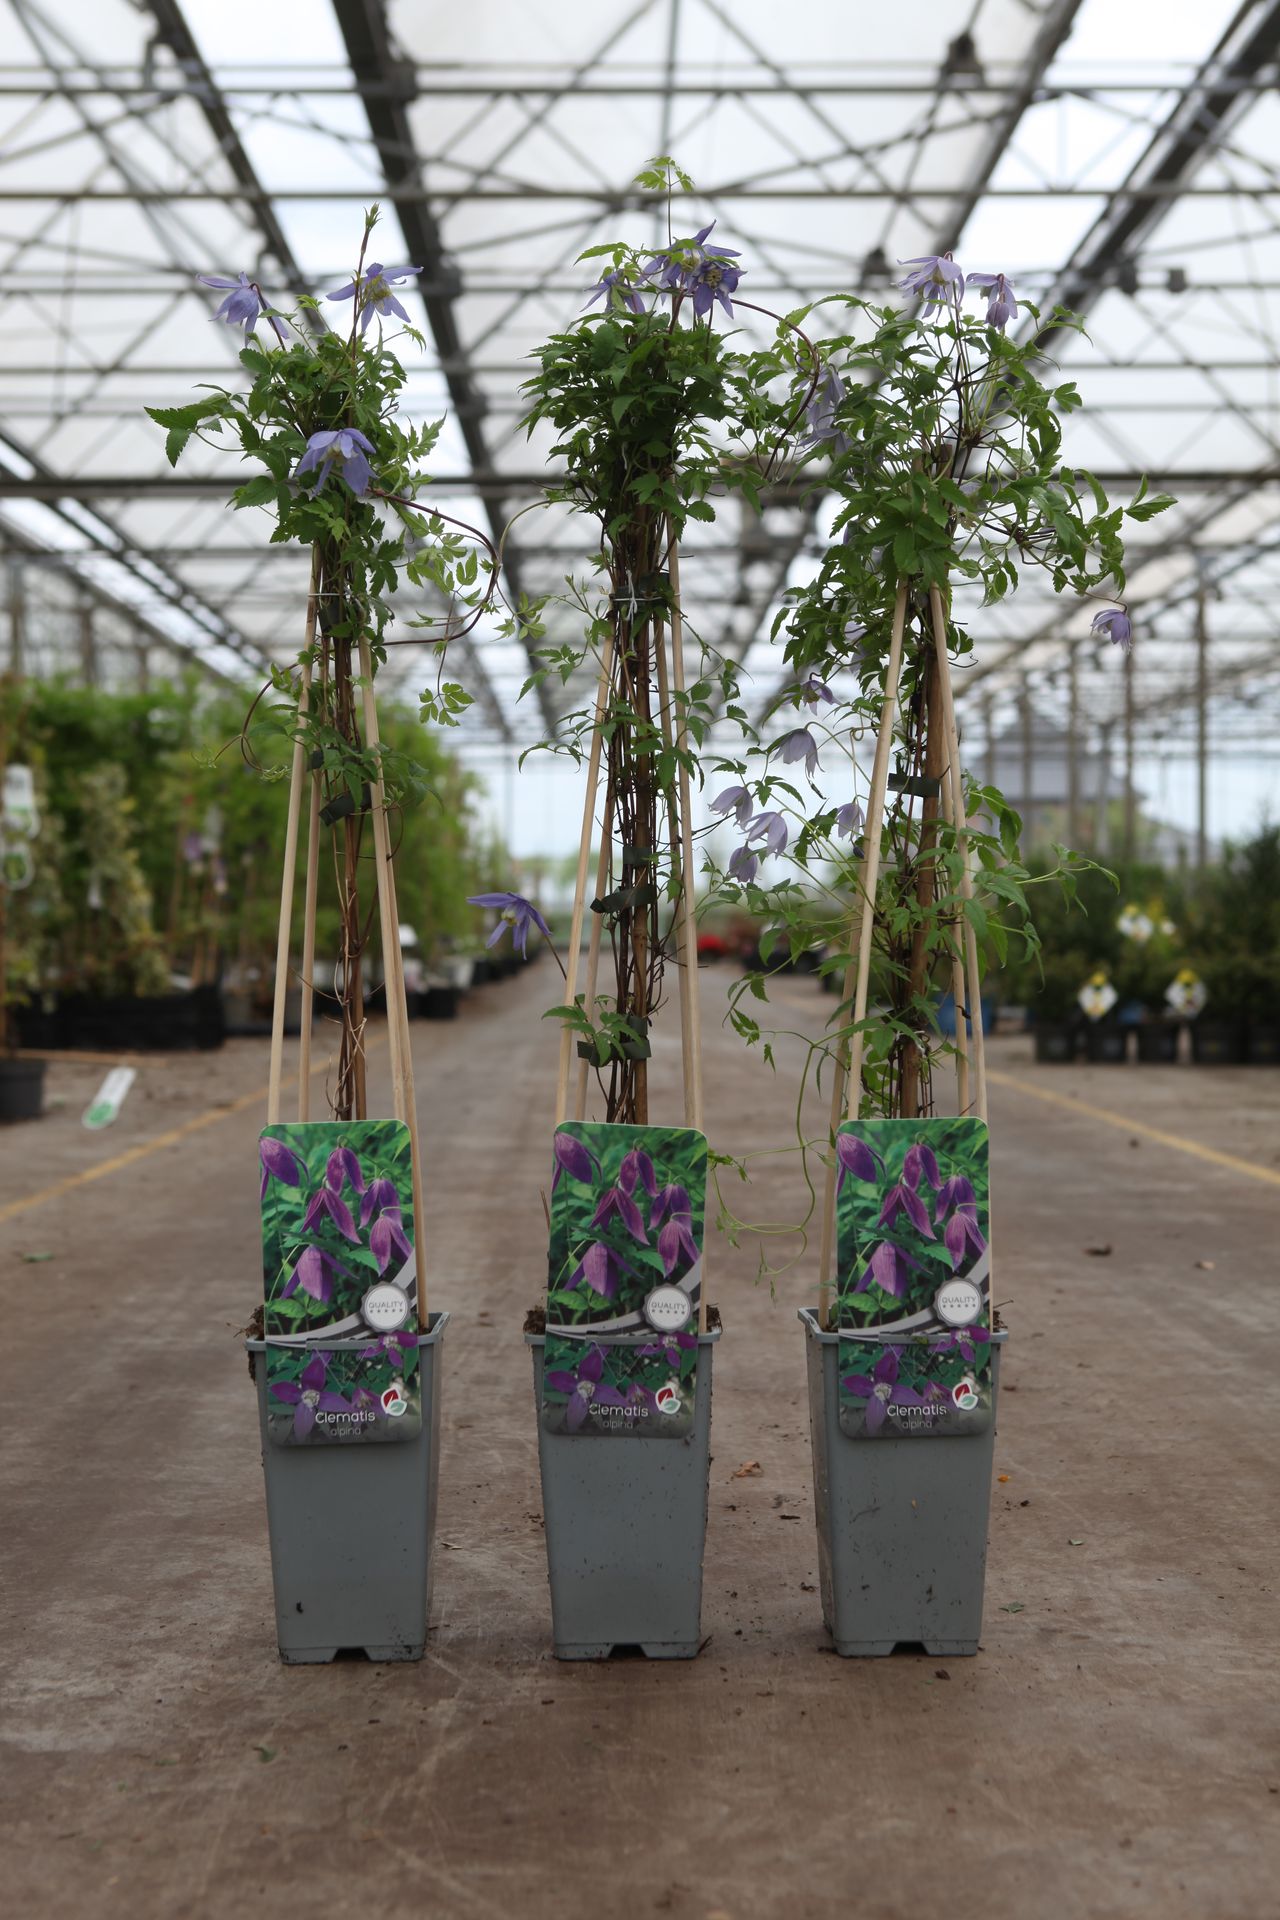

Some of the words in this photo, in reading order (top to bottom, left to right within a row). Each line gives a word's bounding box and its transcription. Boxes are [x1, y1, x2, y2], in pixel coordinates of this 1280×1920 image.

[315, 1410, 376, 1424] Clematis
[588, 1403, 649, 1417] Clematis
[886, 1404, 947, 1417] Clematis
